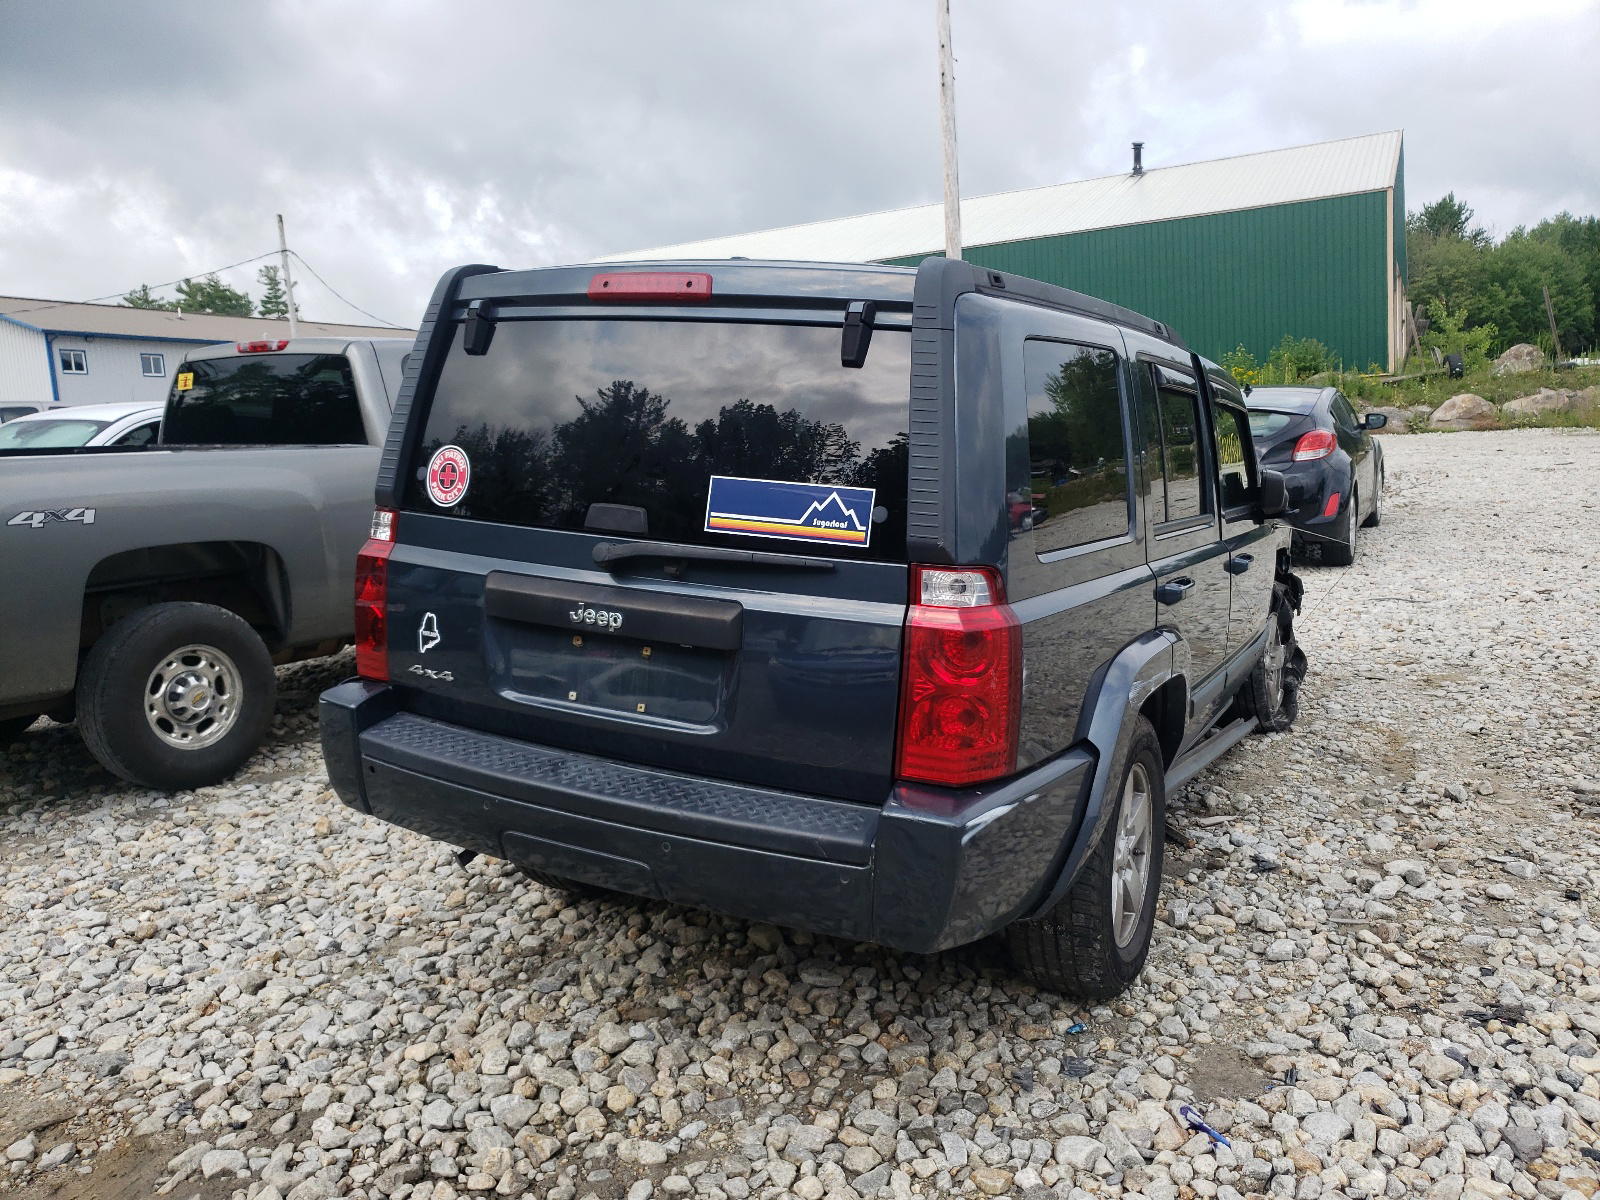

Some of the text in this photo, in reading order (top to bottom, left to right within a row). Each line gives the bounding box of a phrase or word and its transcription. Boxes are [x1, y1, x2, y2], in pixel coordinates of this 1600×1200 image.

[433, 451, 467, 472] SKI PATROL
[431, 481, 463, 501] PARK CITY
[813, 518, 848, 528] Sugarloaf
[569, 602, 623, 632] Jeep
